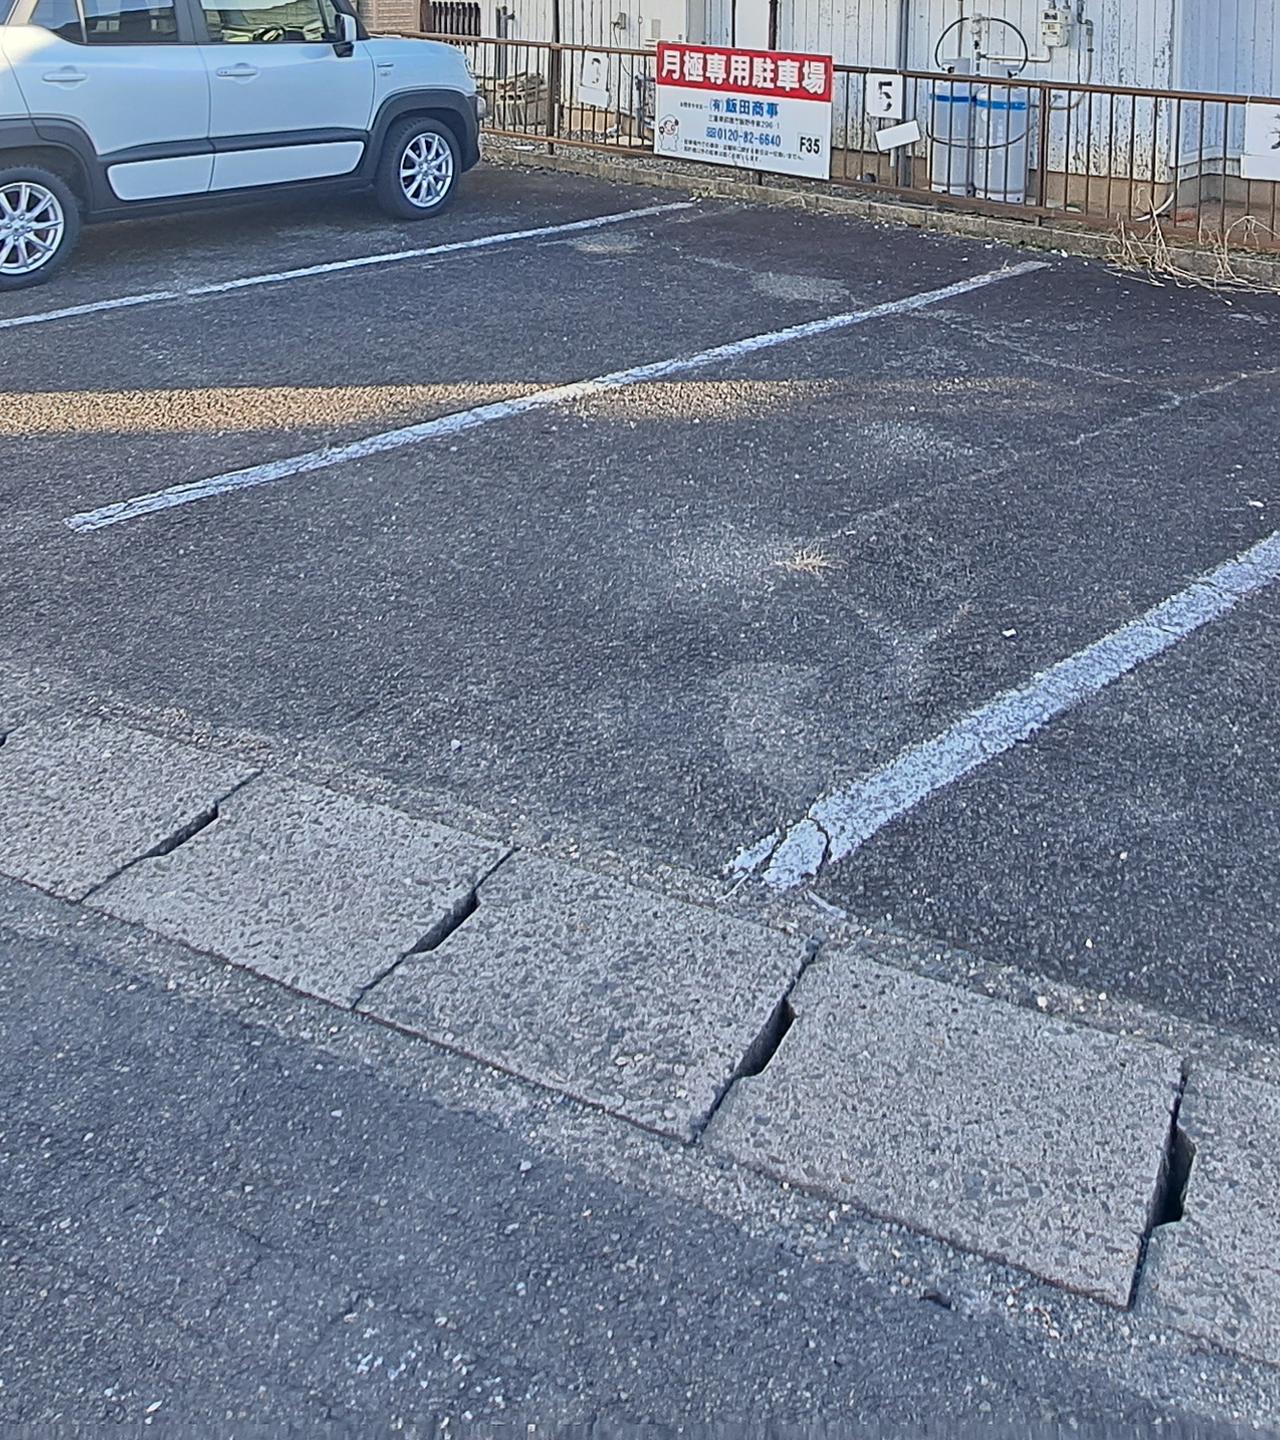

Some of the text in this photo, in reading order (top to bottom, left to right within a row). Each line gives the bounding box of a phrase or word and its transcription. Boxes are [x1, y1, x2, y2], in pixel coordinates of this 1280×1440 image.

[661, 49, 826, 95] 月極専用駐車場
[799, 136, 820, 154] F35
